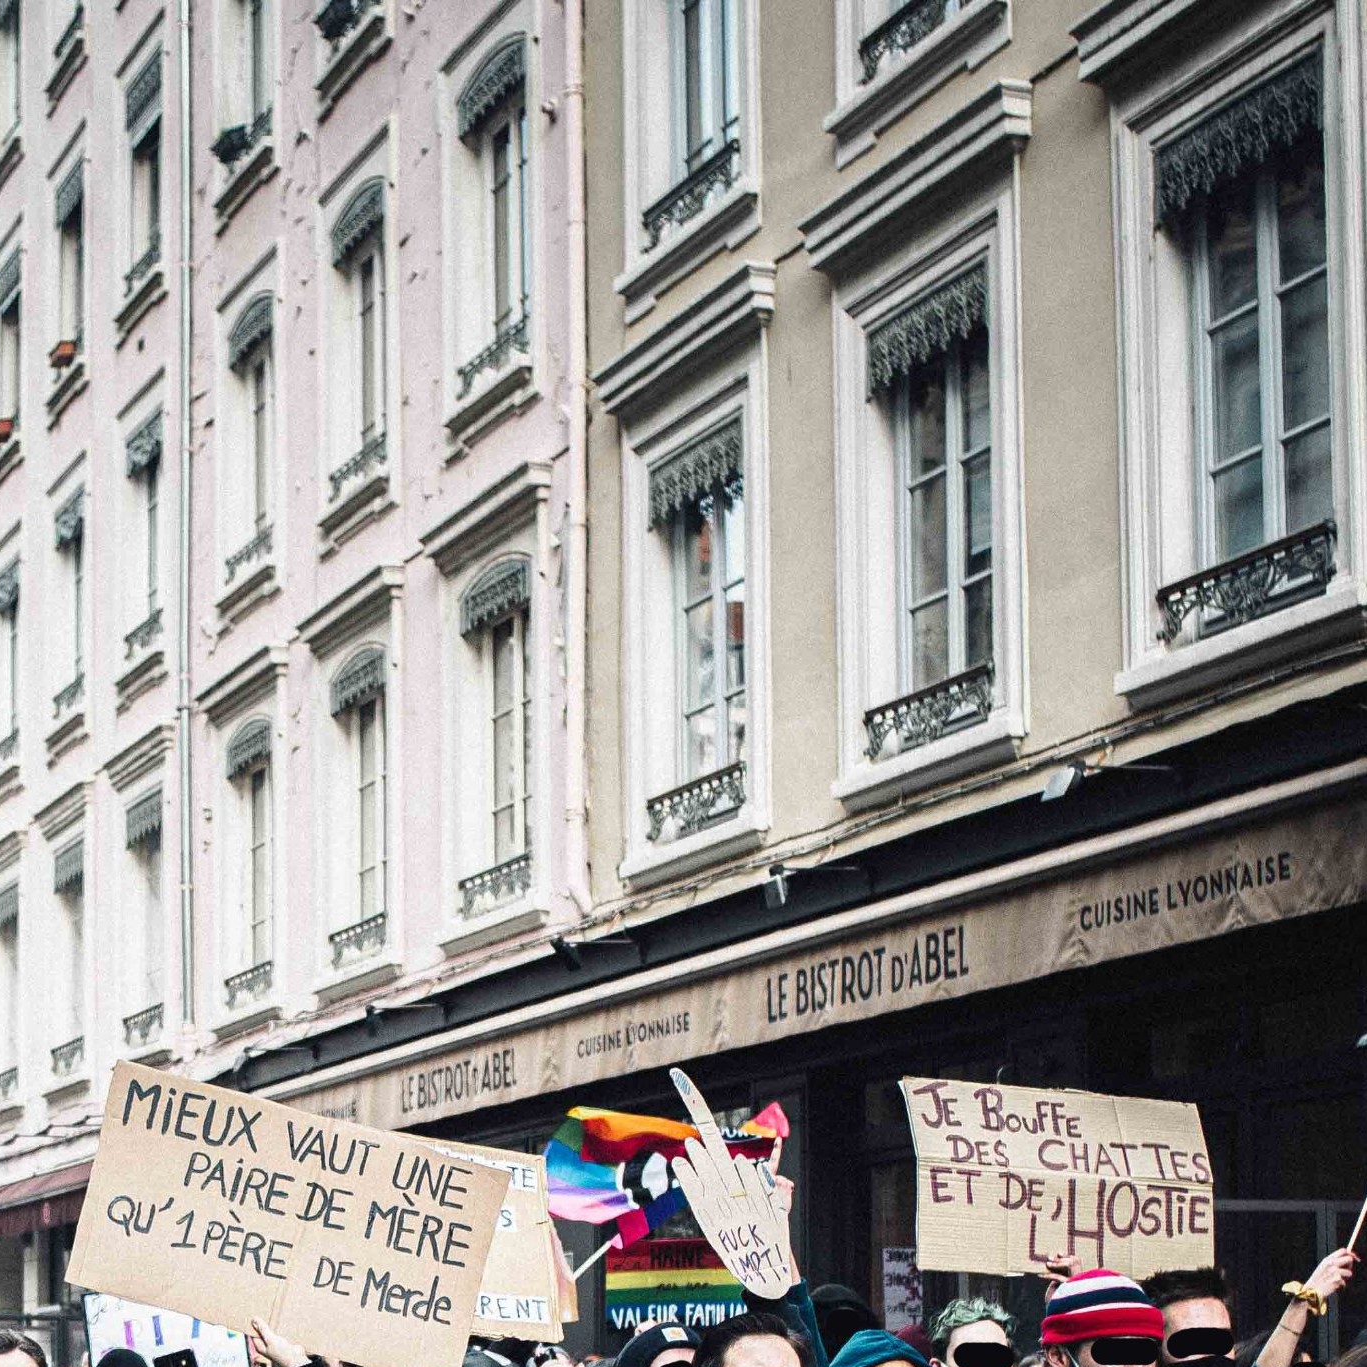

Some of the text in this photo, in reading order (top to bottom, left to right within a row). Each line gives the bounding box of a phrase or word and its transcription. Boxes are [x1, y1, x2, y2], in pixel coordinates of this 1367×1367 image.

[1079, 852, 1292, 932] CUISINE LYONNAISE
[766, 973, 788, 1024] LE
[796, 946, 885, 1016] BISTROT
[577, 1011, 691, 1059] CUISINE LYONNAISE
[401, 1077, 415, 1114] LE
[417, 1060, 471, 1107] BISTROT
[913, 1081, 962, 1129] JE
[287, 1121, 380, 1176] VAUT
[392, 1152, 473, 1210] UNE
[946, 1134, 1211, 1184] DES CHATTES
[930, 1167, 982, 1205] ET
[297, 1182, 354, 1230] DE
[364, 1193, 473, 1268] MÈRE
[718, 1223, 765, 1253] FUCK
[202, 1210, 293, 1279] PÈRE
[313, 1256, 353, 1297] DE
[361, 1267, 452, 1326] Merde
[480, 1295, 546, 1321] RENT
[612, 1304, 679, 1330] VALEUR
